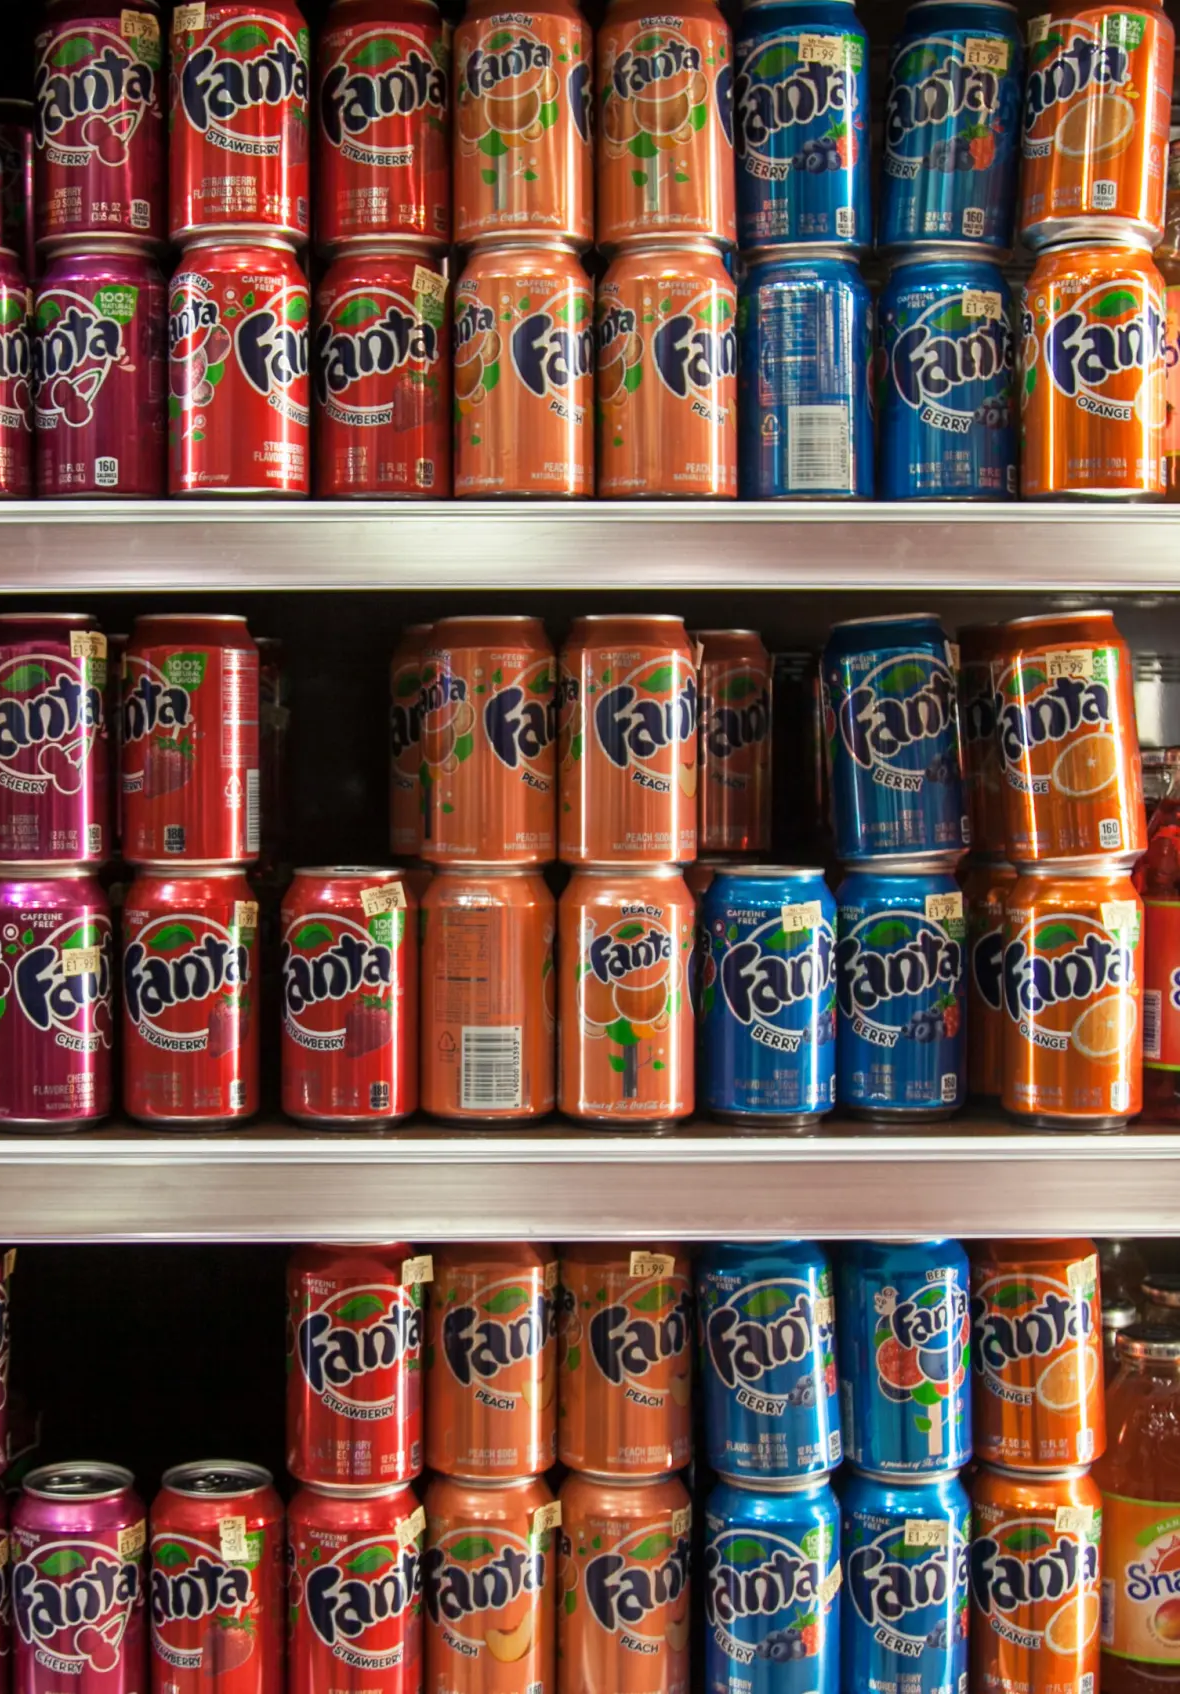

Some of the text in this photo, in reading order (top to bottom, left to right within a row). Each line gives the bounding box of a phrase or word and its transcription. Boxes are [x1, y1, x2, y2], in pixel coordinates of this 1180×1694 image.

[490, 13, 533, 28] PEACH
[640, 15, 684, 30] PEACH
[466, 37, 552, 99] Fanta
[613, 39, 702, 100] Fanta
[36, 45, 154, 149] Fanta
[182, 38, 309, 133] Fanta
[321, 50, 448, 147] Fanta
[733, 57, 857, 157] Fanta
[205, 131, 280, 156] STRAWBERRY
[341, 143, 414, 167] STRAWBERRY
[47, 150, 91, 166] CHERRY
[745, 156, 789, 180] BERRY
[1095, 182, 1114, 195] 160
[99, 292, 134, 304] 100%
[327, 405, 393, 426] STRAWBERRY
[920, 406, 973, 433] BERRY
[1075, 396, 1132, 422] ORANGE
[97, 460, 116, 472] 160
[168, 659, 203, 670] 100%
[631, 771, 672, 794] PEACH
[872, 769, 923, 792] BERRY
[1101, 821, 1118, 835] 160
[20, 913, 63, 922] CAFFEINE
[33, 920, 55, 929] FREE
[621, 905, 663, 918] PEACH
[589, 930, 675, 983] Fanta
[125, 932, 249, 1025] Fanta
[835, 929, 961, 1017] Fanta
[1005, 934, 1131, 1022] Fanta
[55, 1032, 100, 1052] CHERRY
[138, 1025, 209, 1052] STRAWBERRY
[750, 1025, 800, 1053] BERRY
[852, 1021, 899, 1048] BERRY
[891, 1289, 968, 1350] Fanta
[298, 1302, 422, 1395] Fanta
[322, 1393, 395, 1420] STRAWBERRY
[475, 1389, 516, 1410] PEACH
[625, 1388, 664, 1408] PEACH
[736, 1390, 785, 1416] BERRY
[13, 1557, 138, 1644] Fanta
[441, 1632, 479, 1658] PEACH
[620, 1635, 659, 1654] PEACH
[874, 1629, 924, 1657] BERRY
[990, 1617, 1041, 1648] ORANGE
[333, 1643, 404, 1669] STRAWBERRY
[714, 1629, 754, 1665] BERRY
[35, 1650, 83, 1674] CHERRY
